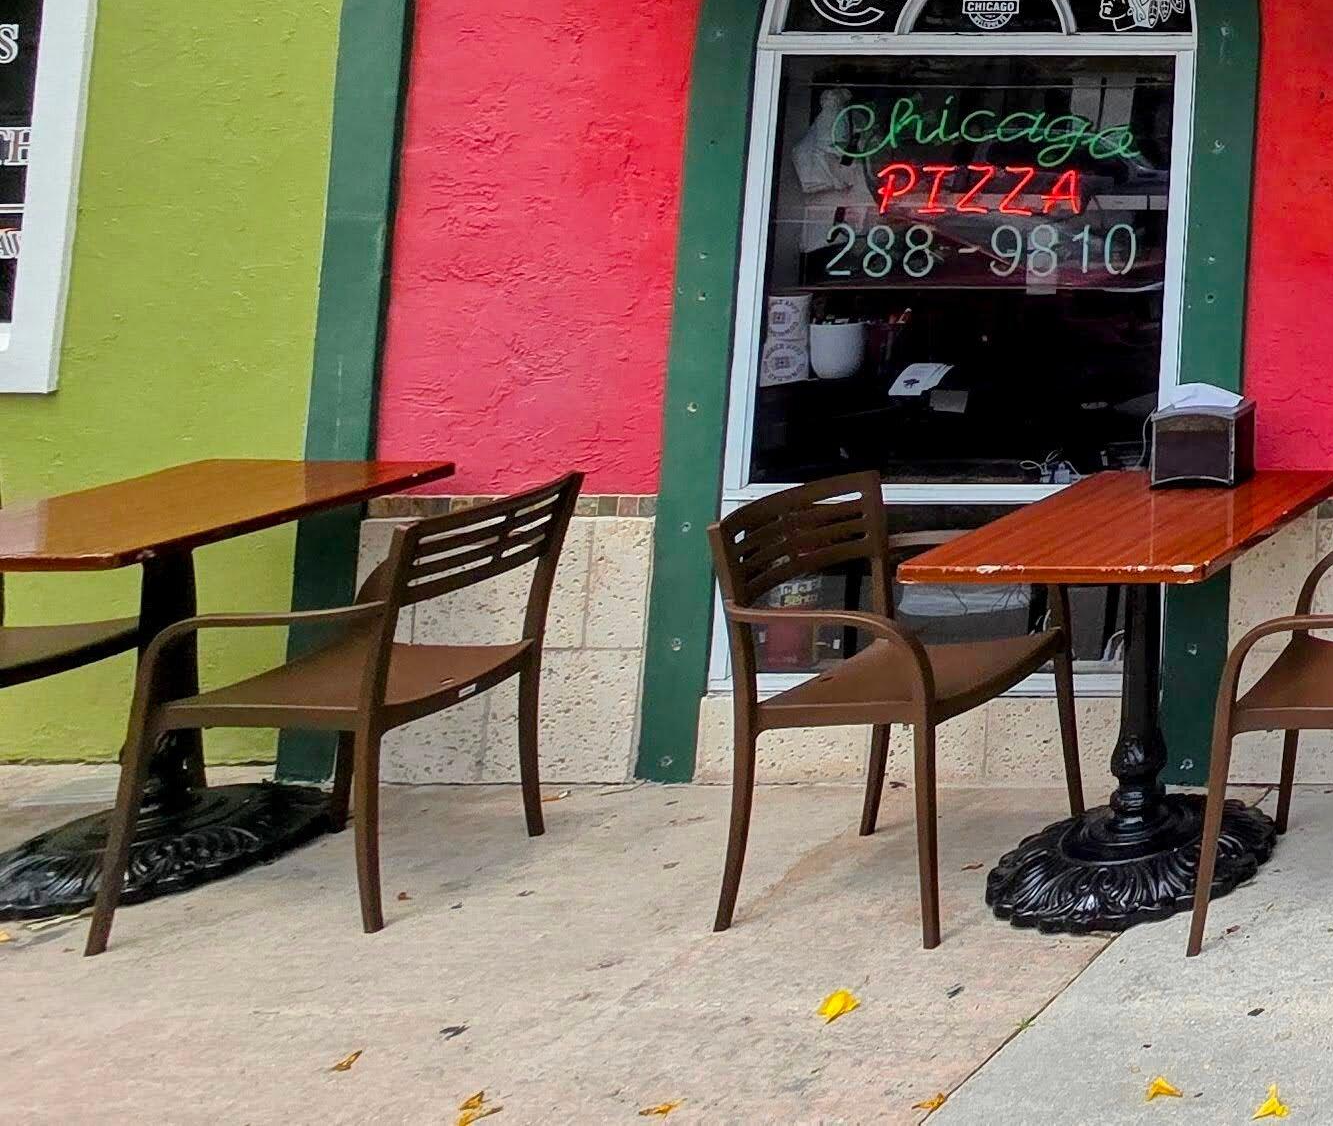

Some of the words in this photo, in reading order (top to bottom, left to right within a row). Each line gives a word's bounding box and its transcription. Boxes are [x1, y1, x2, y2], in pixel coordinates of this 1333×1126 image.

[967, 1, 1015, 12] CHICAGO
[832, 97, 1141, 168] Chicago
[877, 163, 1081, 216] PIZZA
